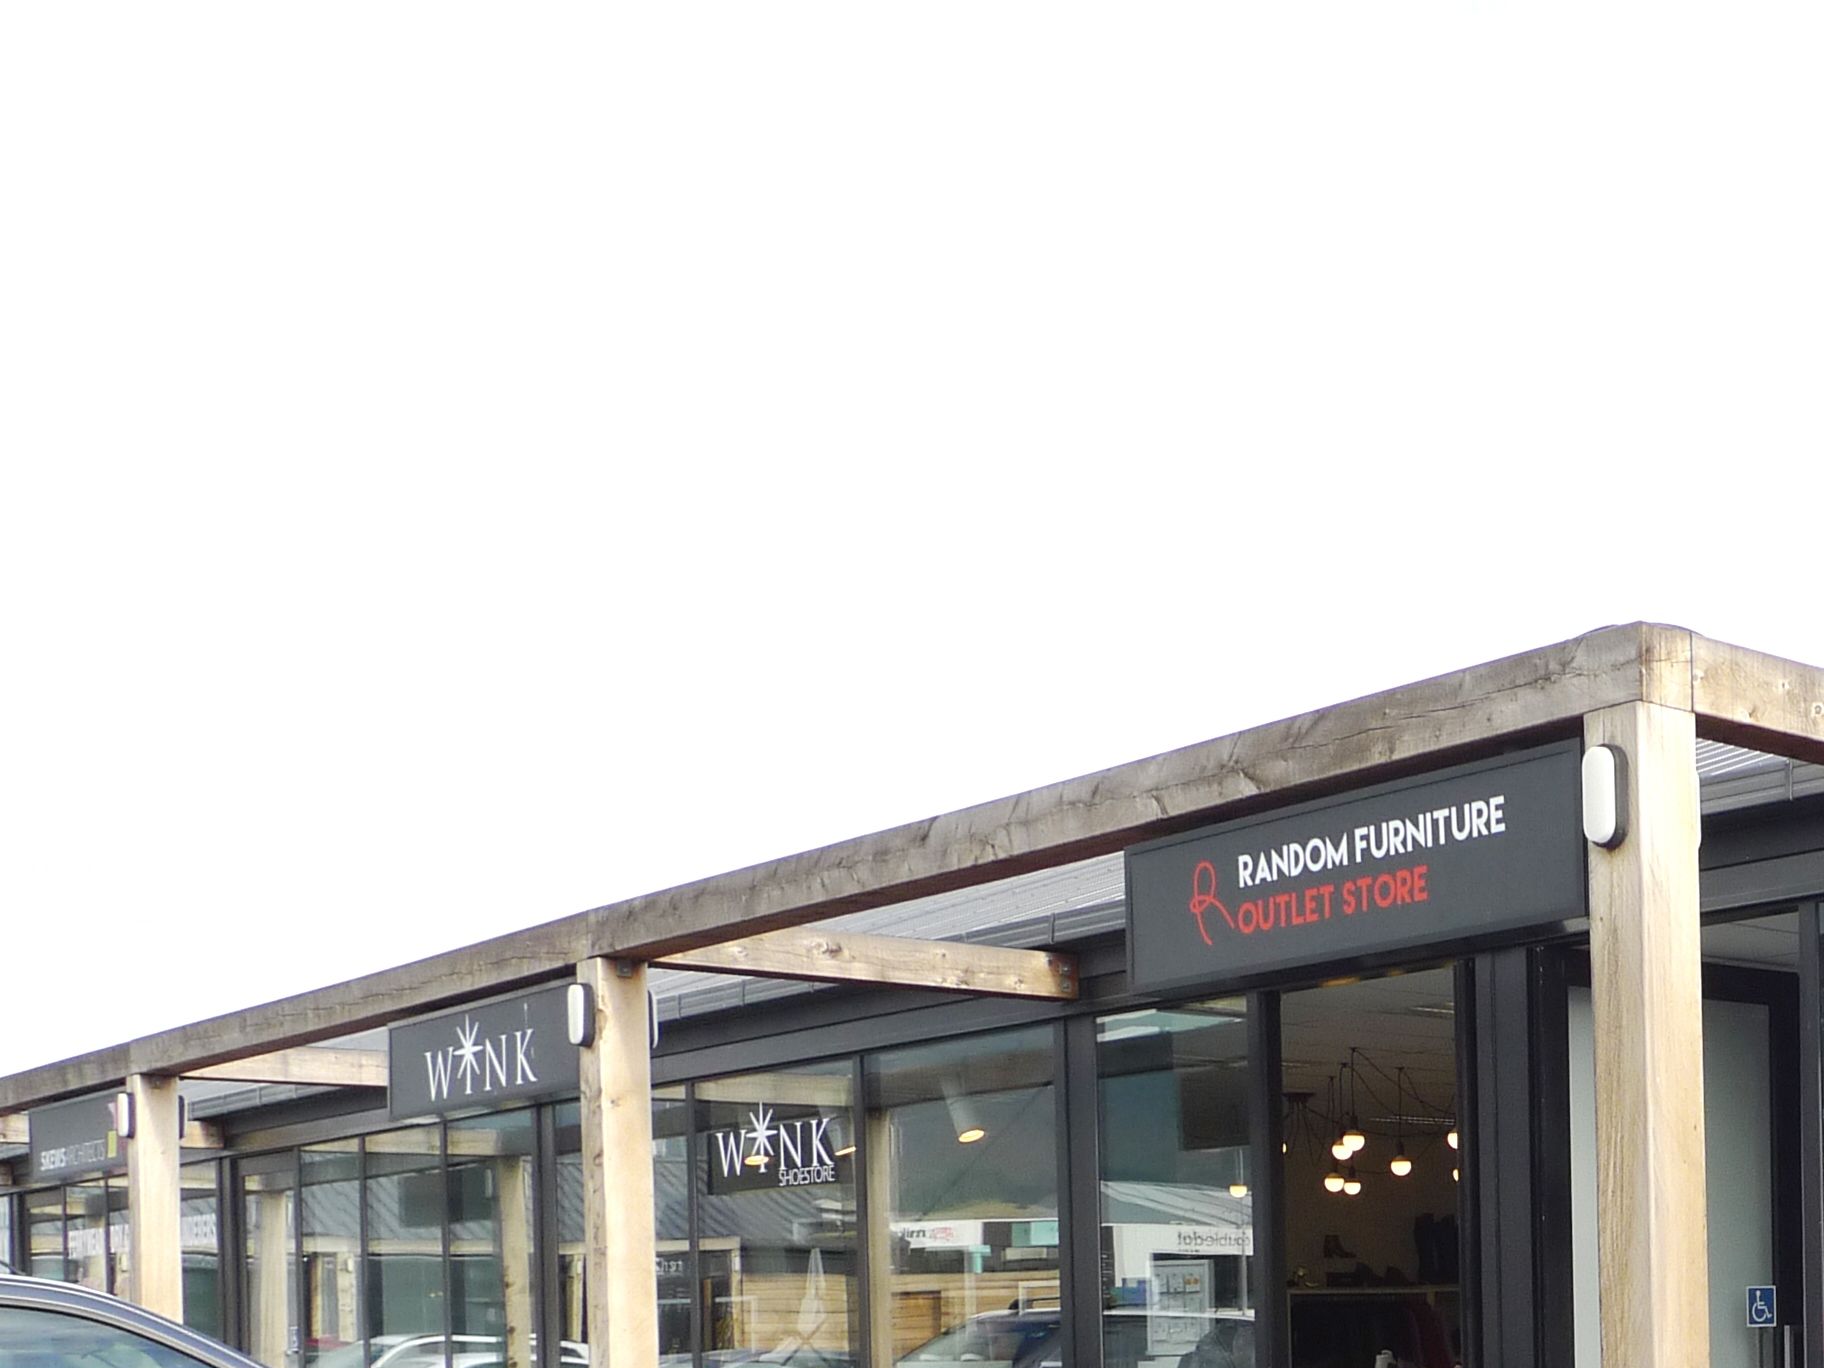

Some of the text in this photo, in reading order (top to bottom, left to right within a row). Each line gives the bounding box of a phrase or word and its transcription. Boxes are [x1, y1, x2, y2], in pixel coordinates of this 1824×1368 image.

[1238, 795, 1506, 889] RANDOM FURNITURE
[1238, 864, 1429, 935] OUTLET STORE
[778, 1163, 836, 1187] SHOESTORE
